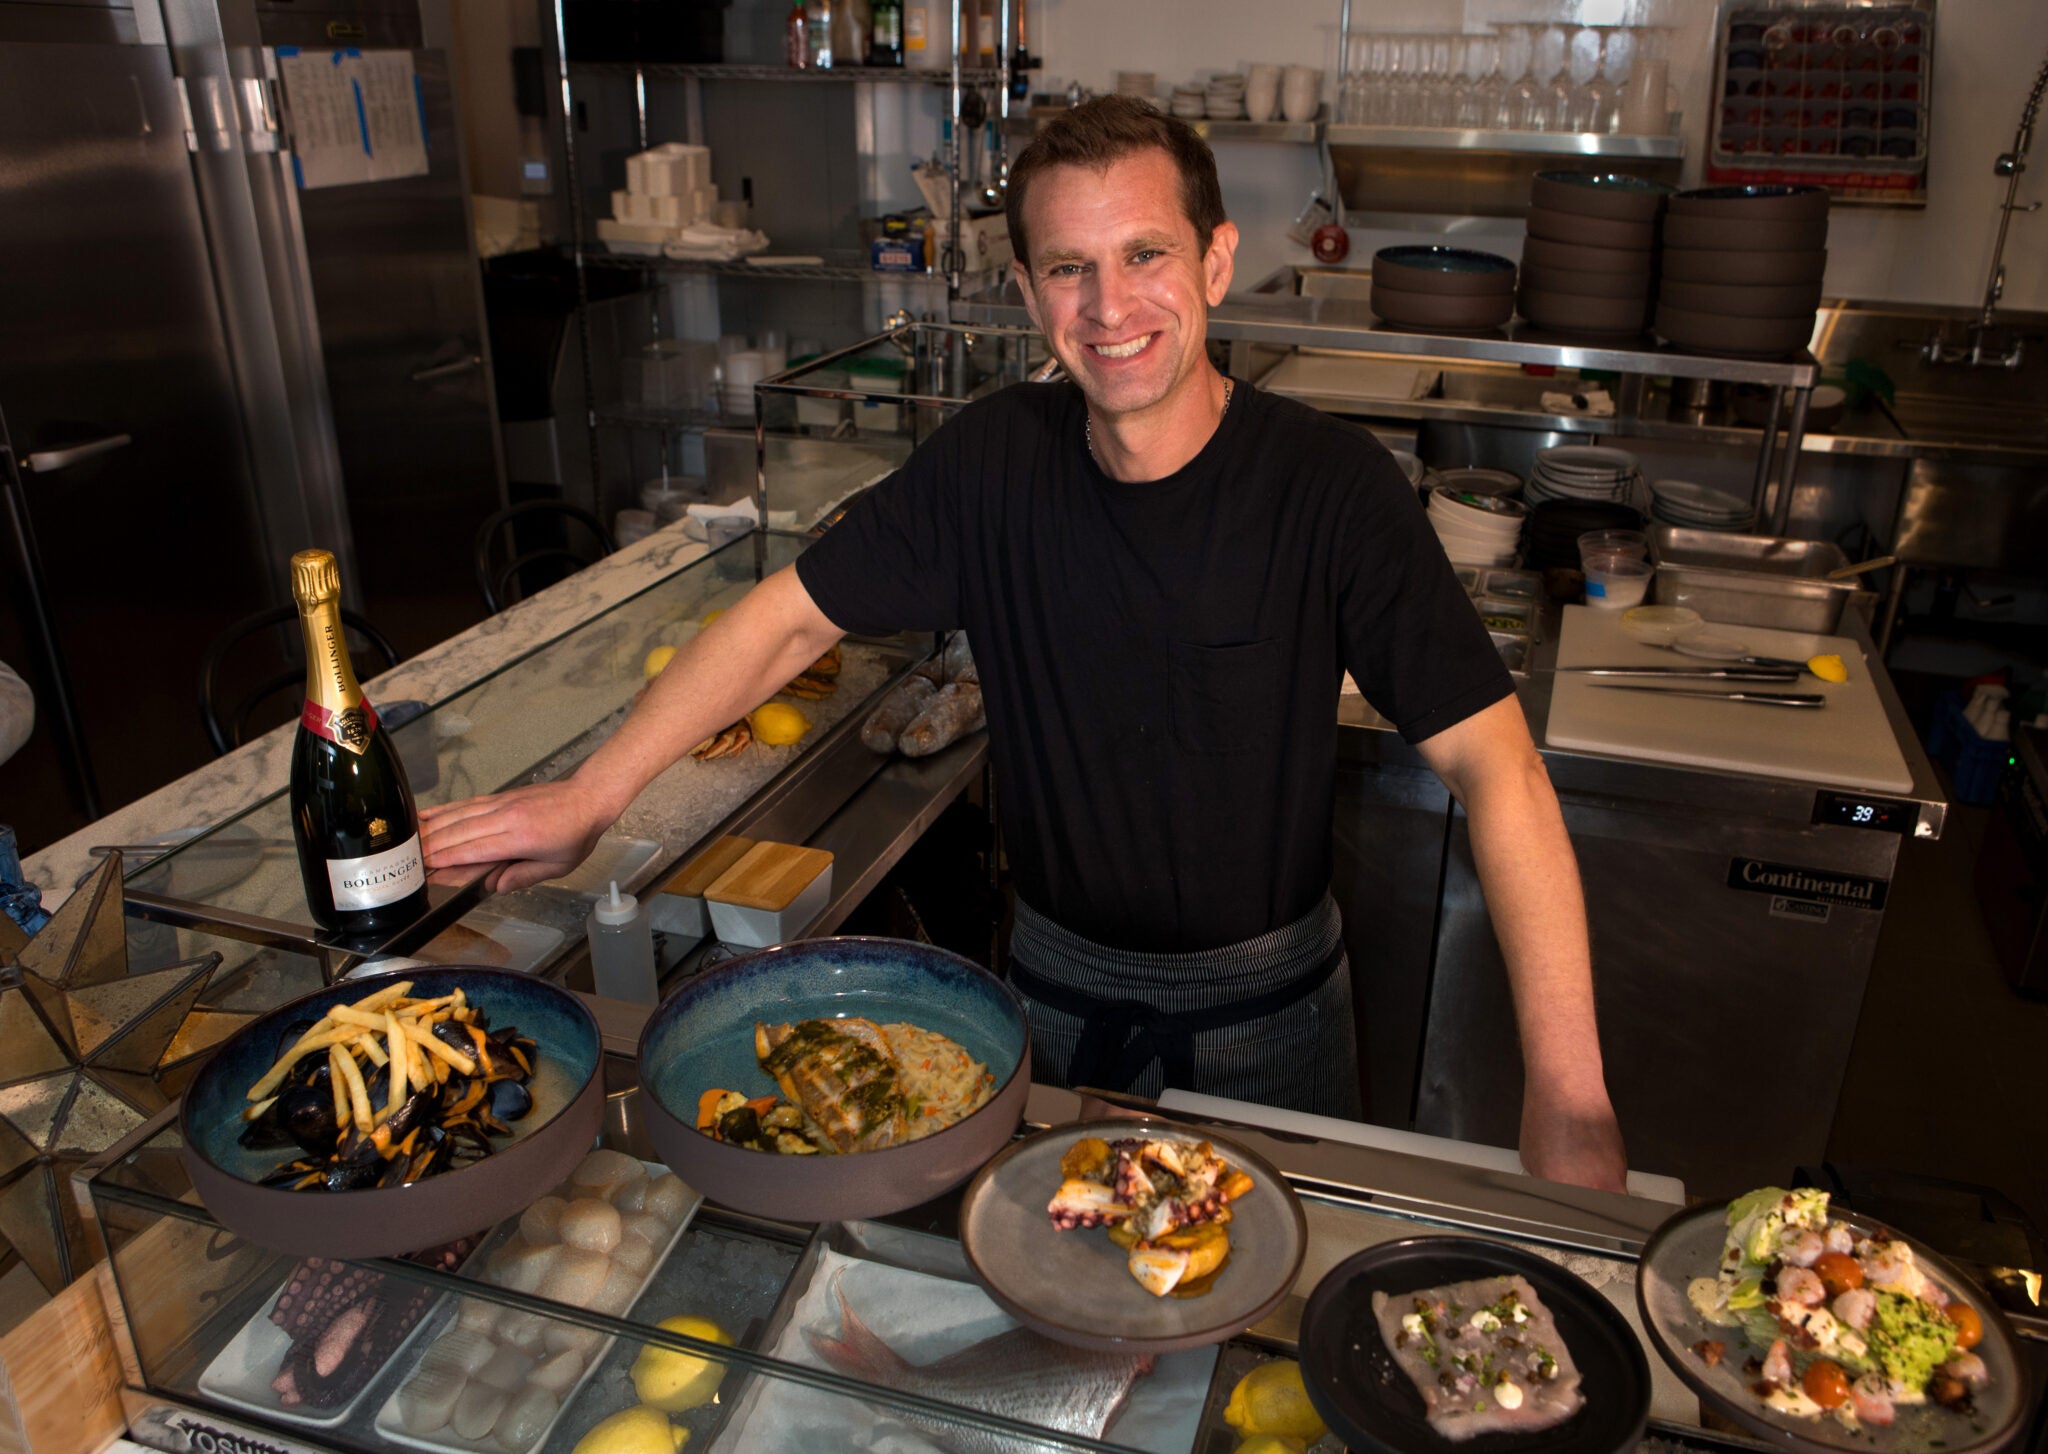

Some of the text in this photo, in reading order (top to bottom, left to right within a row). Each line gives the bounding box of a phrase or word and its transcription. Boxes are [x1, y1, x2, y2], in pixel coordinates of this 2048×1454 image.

[325, 624, 346, 692] BOLLINGER
[1852, 805, 1873, 821] 39
[343, 858, 418, 889] BOLLINGER
[1742, 861, 1875, 900] Continental
